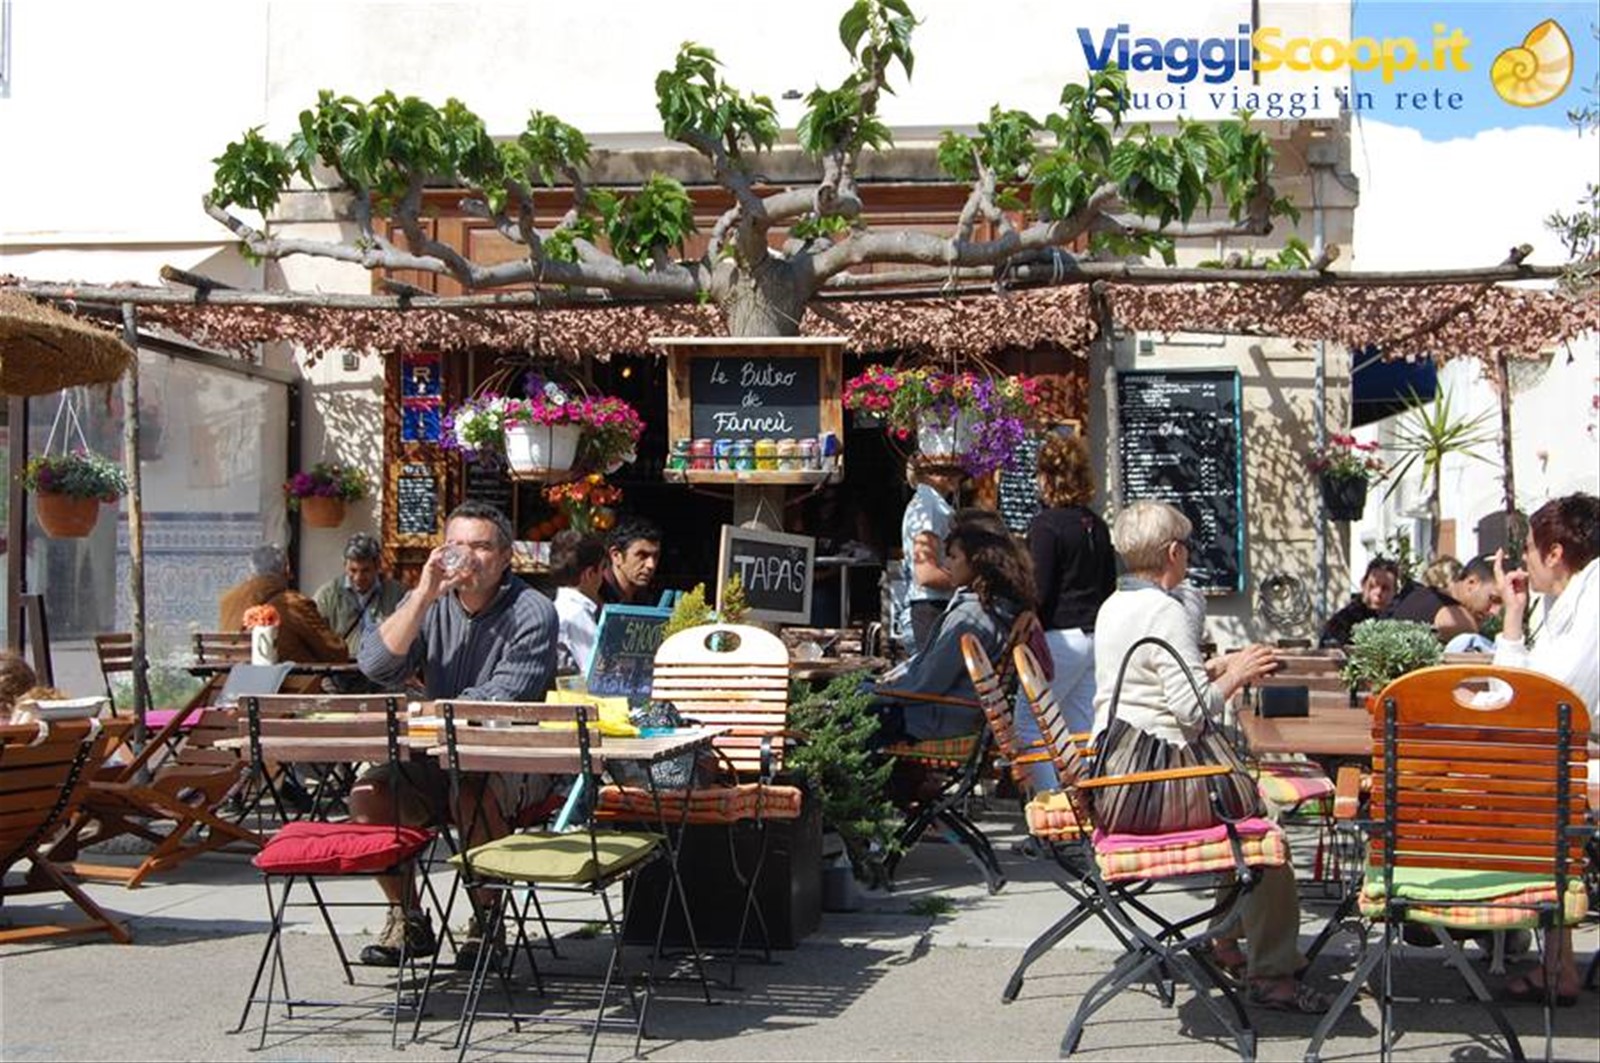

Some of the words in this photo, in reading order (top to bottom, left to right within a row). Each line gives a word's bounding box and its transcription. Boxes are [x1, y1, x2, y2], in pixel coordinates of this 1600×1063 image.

[710, 361, 729, 384] Le
[741, 390, 763, 408] de
[734, 555, 806, 593] TAPAS
